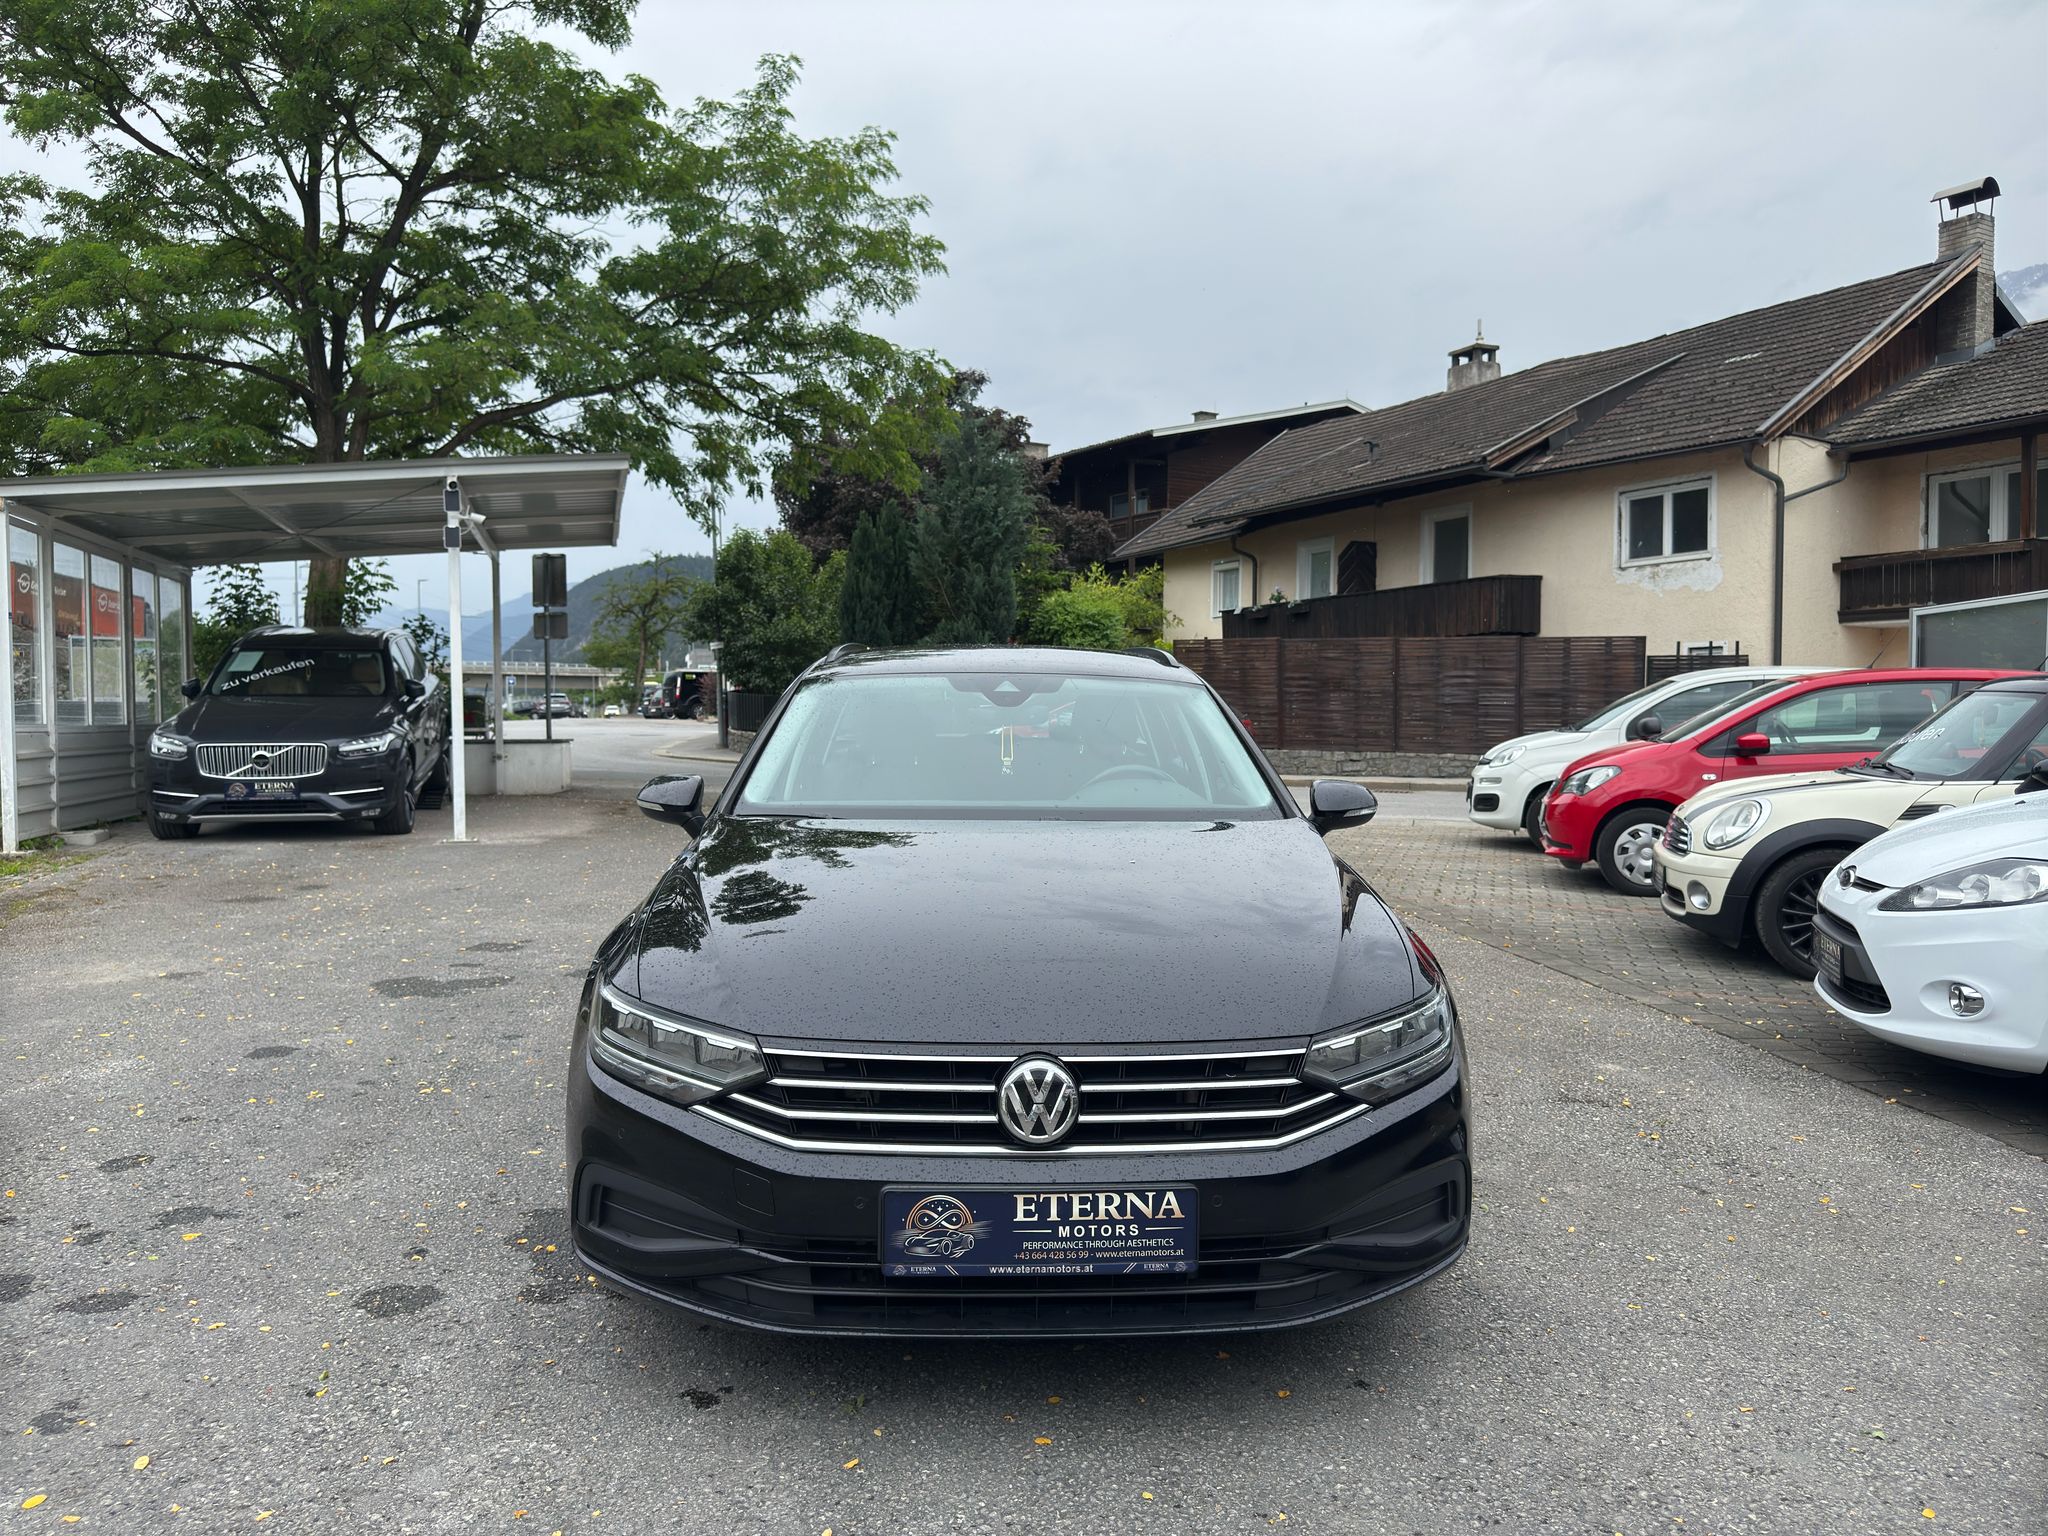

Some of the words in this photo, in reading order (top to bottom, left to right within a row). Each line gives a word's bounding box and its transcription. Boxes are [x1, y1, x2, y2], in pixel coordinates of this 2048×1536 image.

[221, 679, 240, 691] zu
[241, 658, 315, 683] verkaufen
[254, 781, 295, 790] ETERNA
[1013, 1191, 1185, 1222] ETERNA
[1058, 1224, 1139, 1238] MOTORS
[1023, 1241, 1084, 1250] PERFORMANCE
[1084, 1239, 1125, 1249] THROUGH
[1127, 1238, 1174, 1248] AESTHETICS
[1014, 1251, 1030, 1260] +43
[1031, 1251, 1047, 1260] 664
[1048, 1251, 1065, 1260] 428
[1066, 1251, 1077, 1259] 56
[1078, 1250, 1089, 1259] 99
[1095, 1248, 1185, 1258] www.eternamotors.at
[989, 1264, 1094, 1274] www.eternamotors.at
